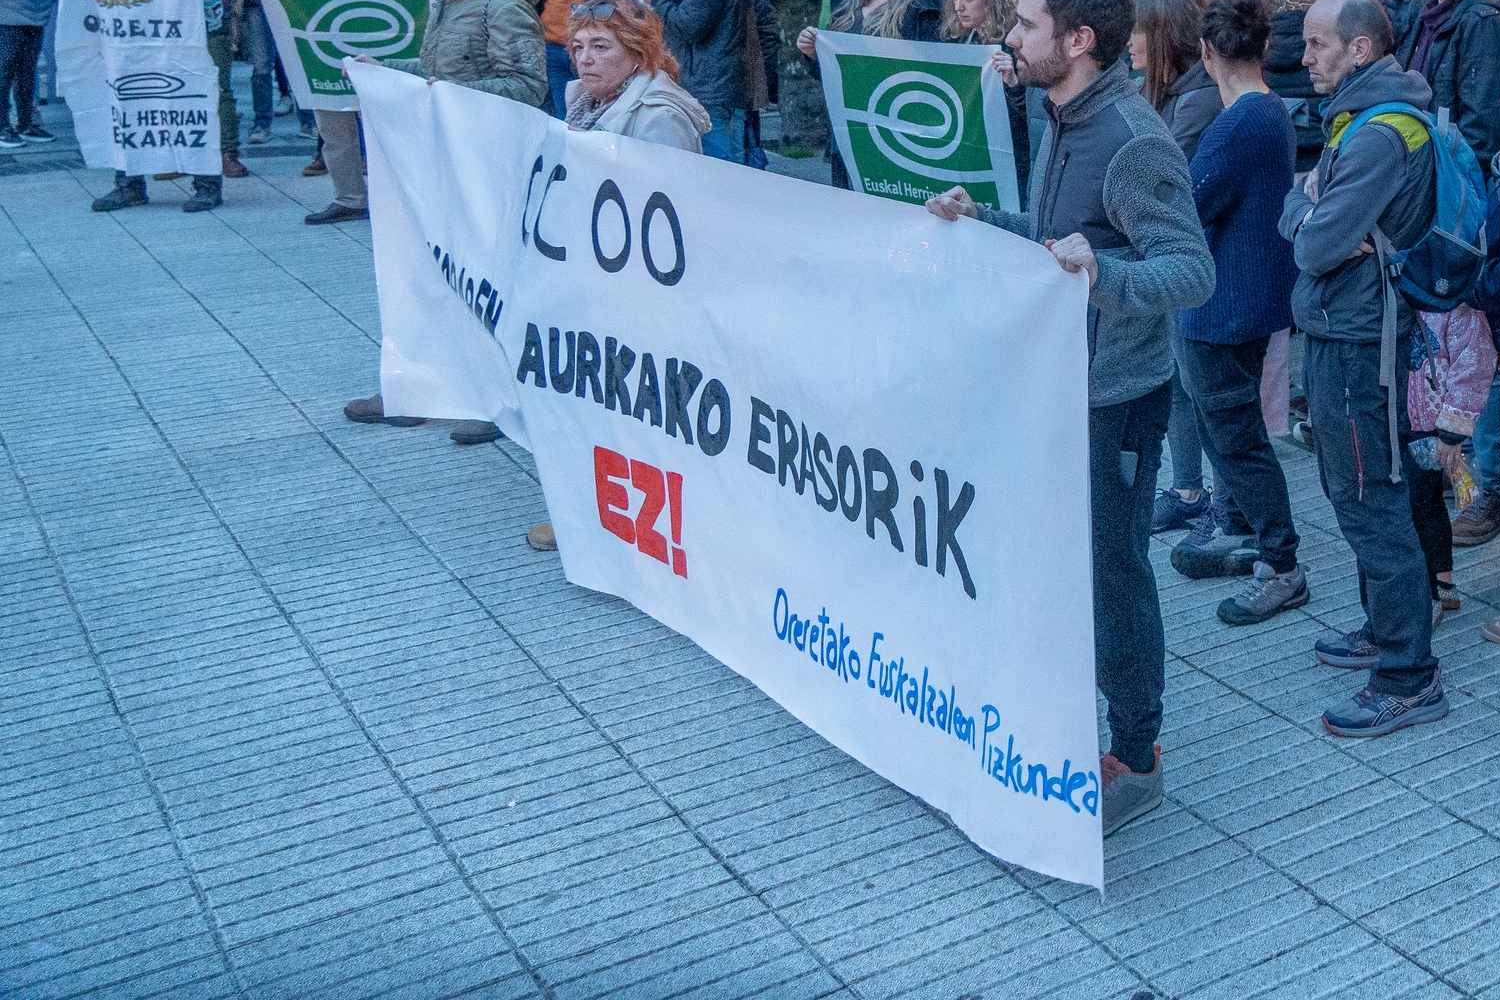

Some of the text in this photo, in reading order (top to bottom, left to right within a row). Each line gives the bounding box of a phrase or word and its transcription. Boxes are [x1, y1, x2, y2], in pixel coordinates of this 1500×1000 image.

[138, 110, 208, 127] HERRIAN
[864, 177, 902, 196] Euskal
[516, 322, 731, 457] AURKAKO
[593, 445, 688, 580] EZ!
[773, 588, 861, 684] Oreretako
[981, 704, 1099, 818] Pizkundea
